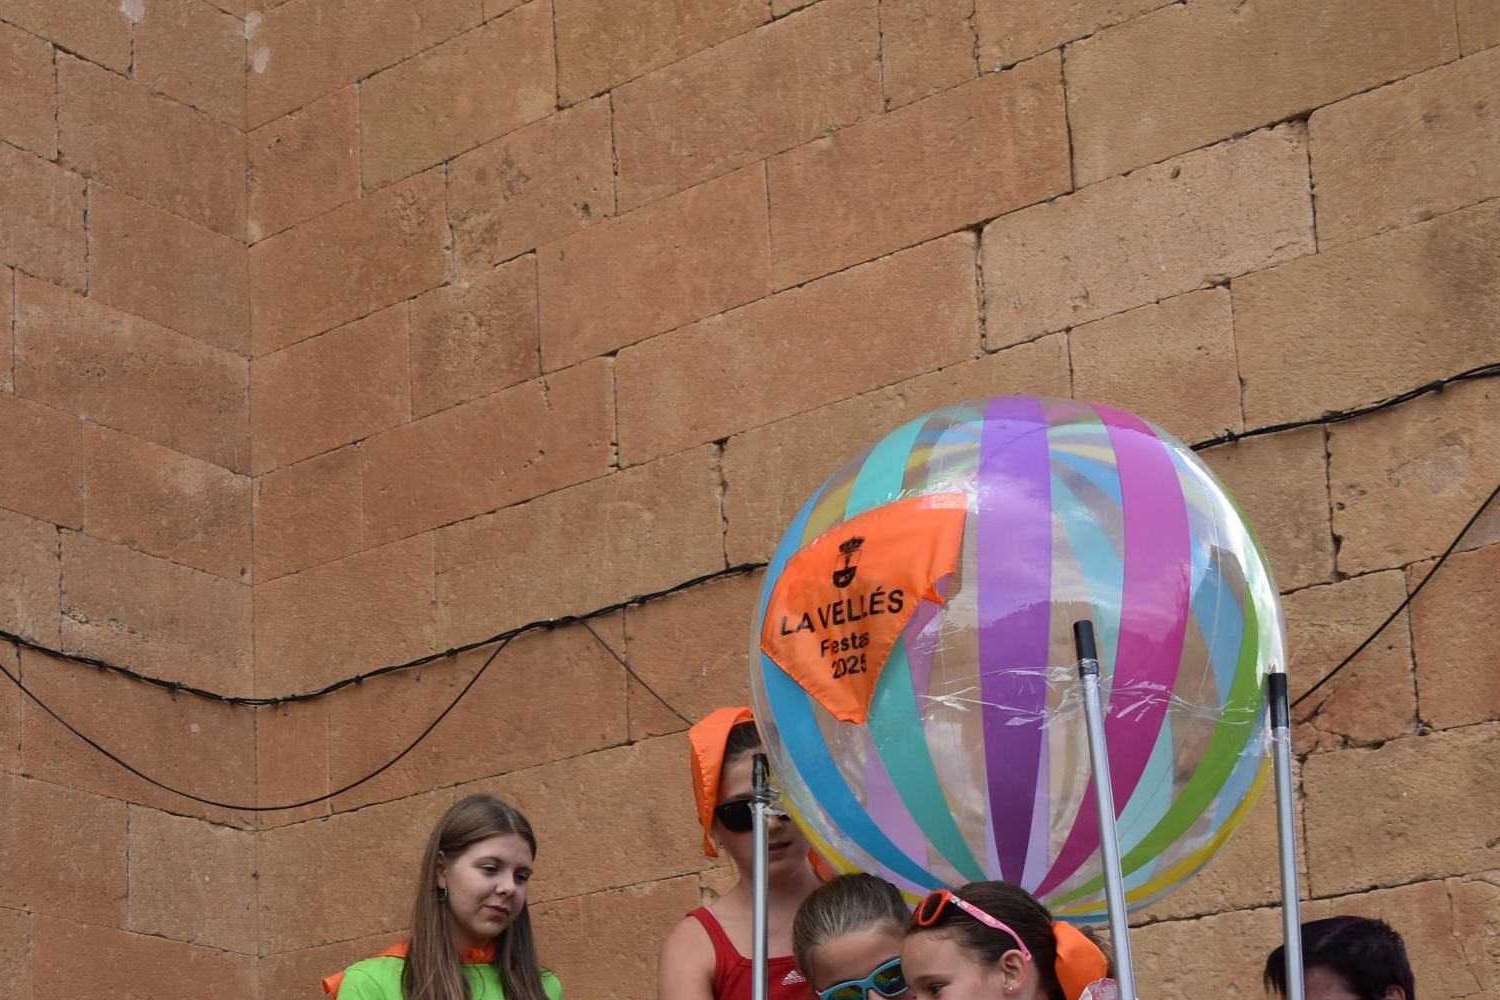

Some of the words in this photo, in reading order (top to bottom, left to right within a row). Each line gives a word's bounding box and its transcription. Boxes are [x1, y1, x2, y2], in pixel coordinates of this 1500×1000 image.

[780, 611, 816, 637] LA
[817, 586, 904, 630] VELLÉS
[831, 653, 868, 680] 2025
